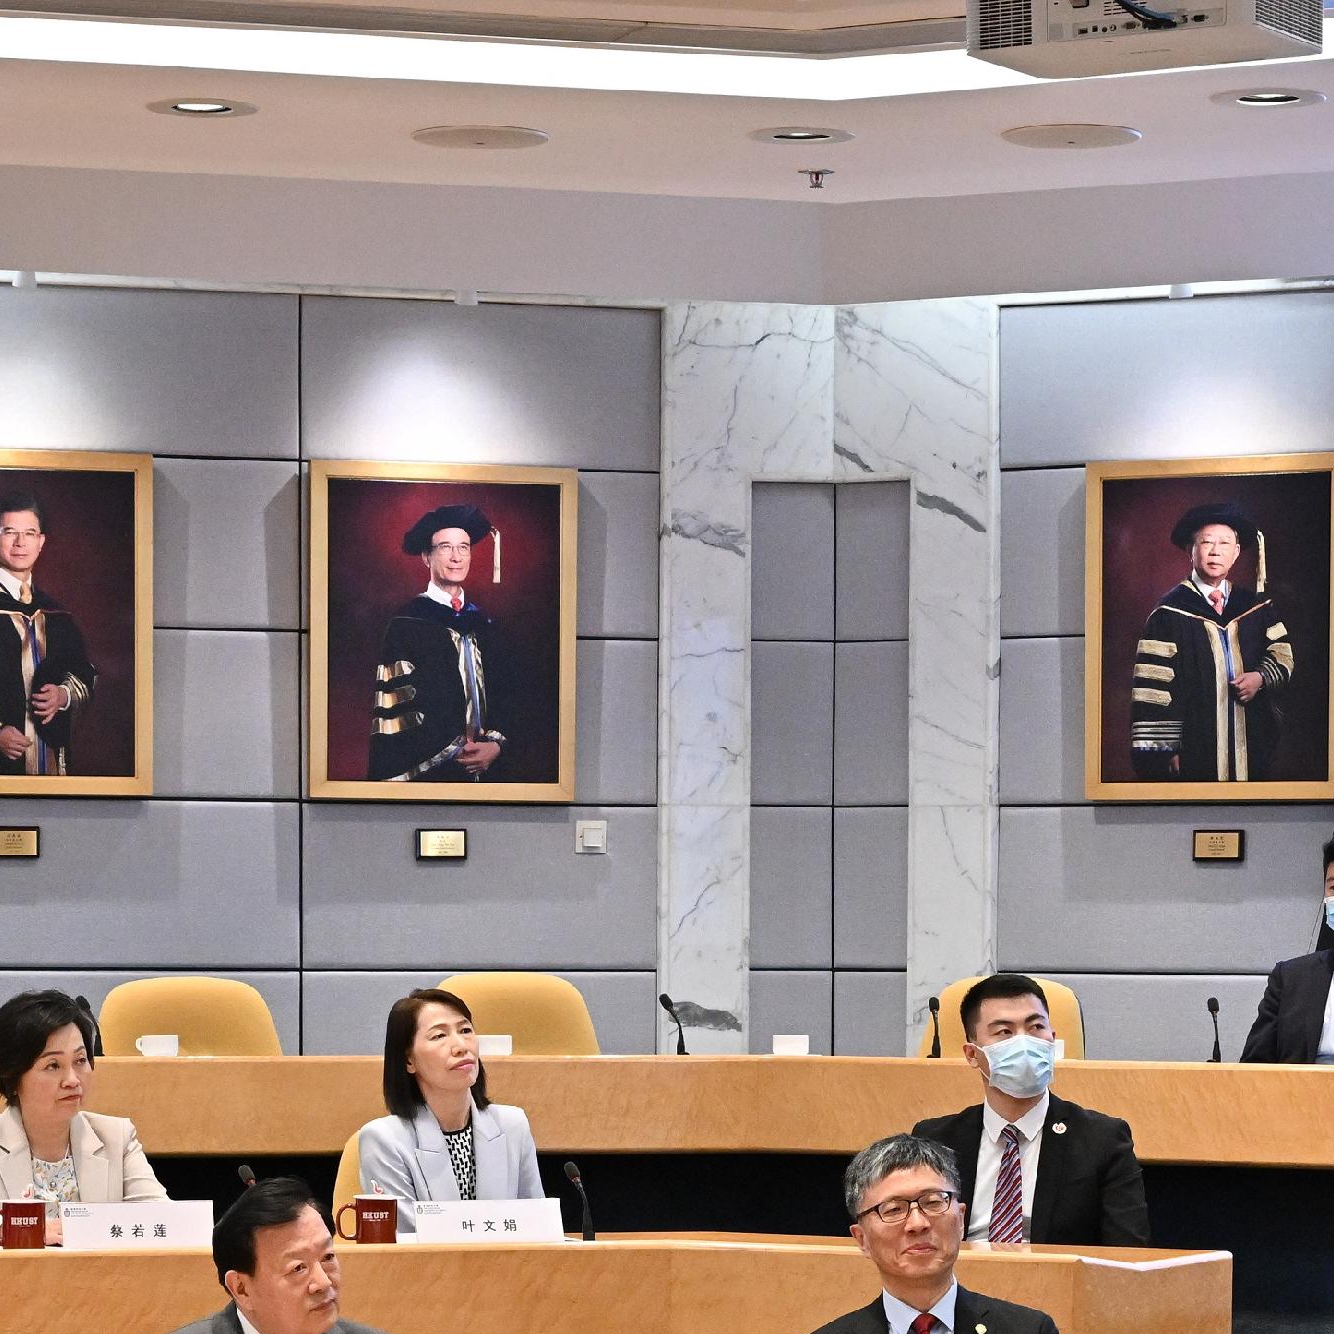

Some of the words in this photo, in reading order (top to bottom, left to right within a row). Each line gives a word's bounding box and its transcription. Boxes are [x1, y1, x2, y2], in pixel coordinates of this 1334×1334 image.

[362, 1211, 390, 1220] HKUST
[10, 1216, 39, 1226] HKUST
[462, 1218, 517, 1232] 叶文娟
